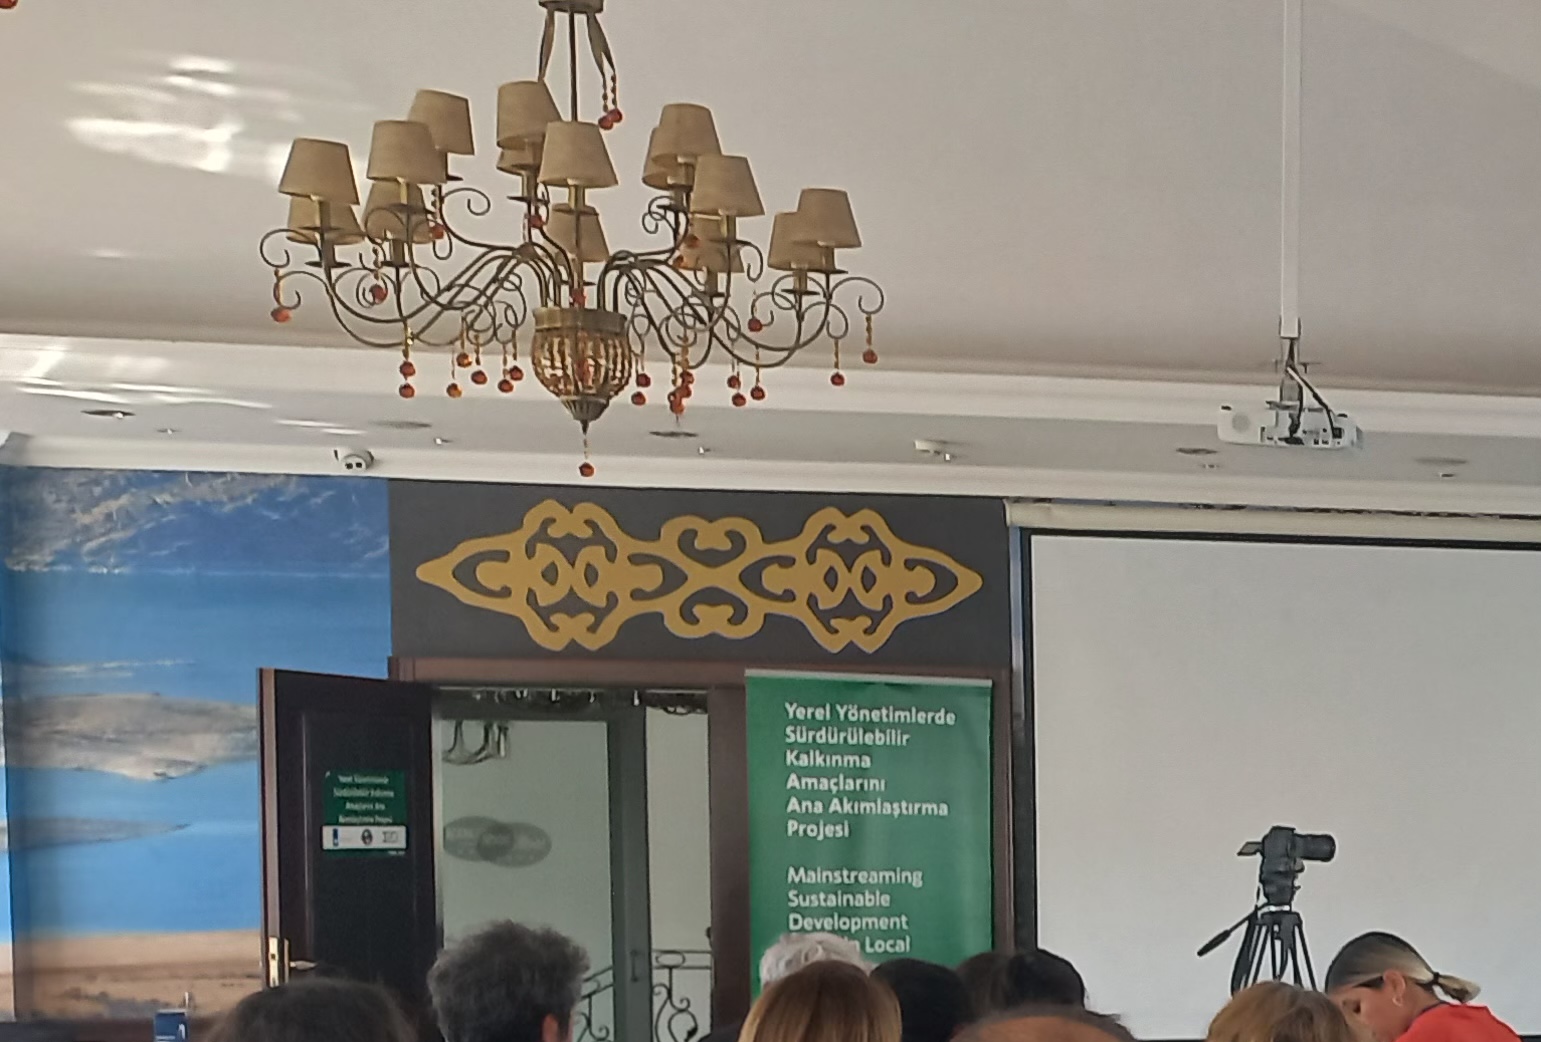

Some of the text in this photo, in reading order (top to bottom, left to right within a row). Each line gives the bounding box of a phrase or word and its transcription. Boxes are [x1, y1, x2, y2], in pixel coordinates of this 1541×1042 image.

[785, 702, 956, 725] Yerel Yönetimlerde
[785, 726, 910, 746] Sürdürülebilir
[785, 750, 872, 768] Kalkınma
[786, 773, 886, 793] Amaçlarını
[786, 796, 949, 818] Ana Akımlaştırma
[787, 819, 849, 840] Projesi
[787, 867, 923, 888] Mainstreaming
[788, 890, 891, 907] Sustainable
[788, 912, 908, 934] Development
[865, 935, 911, 953] Local
